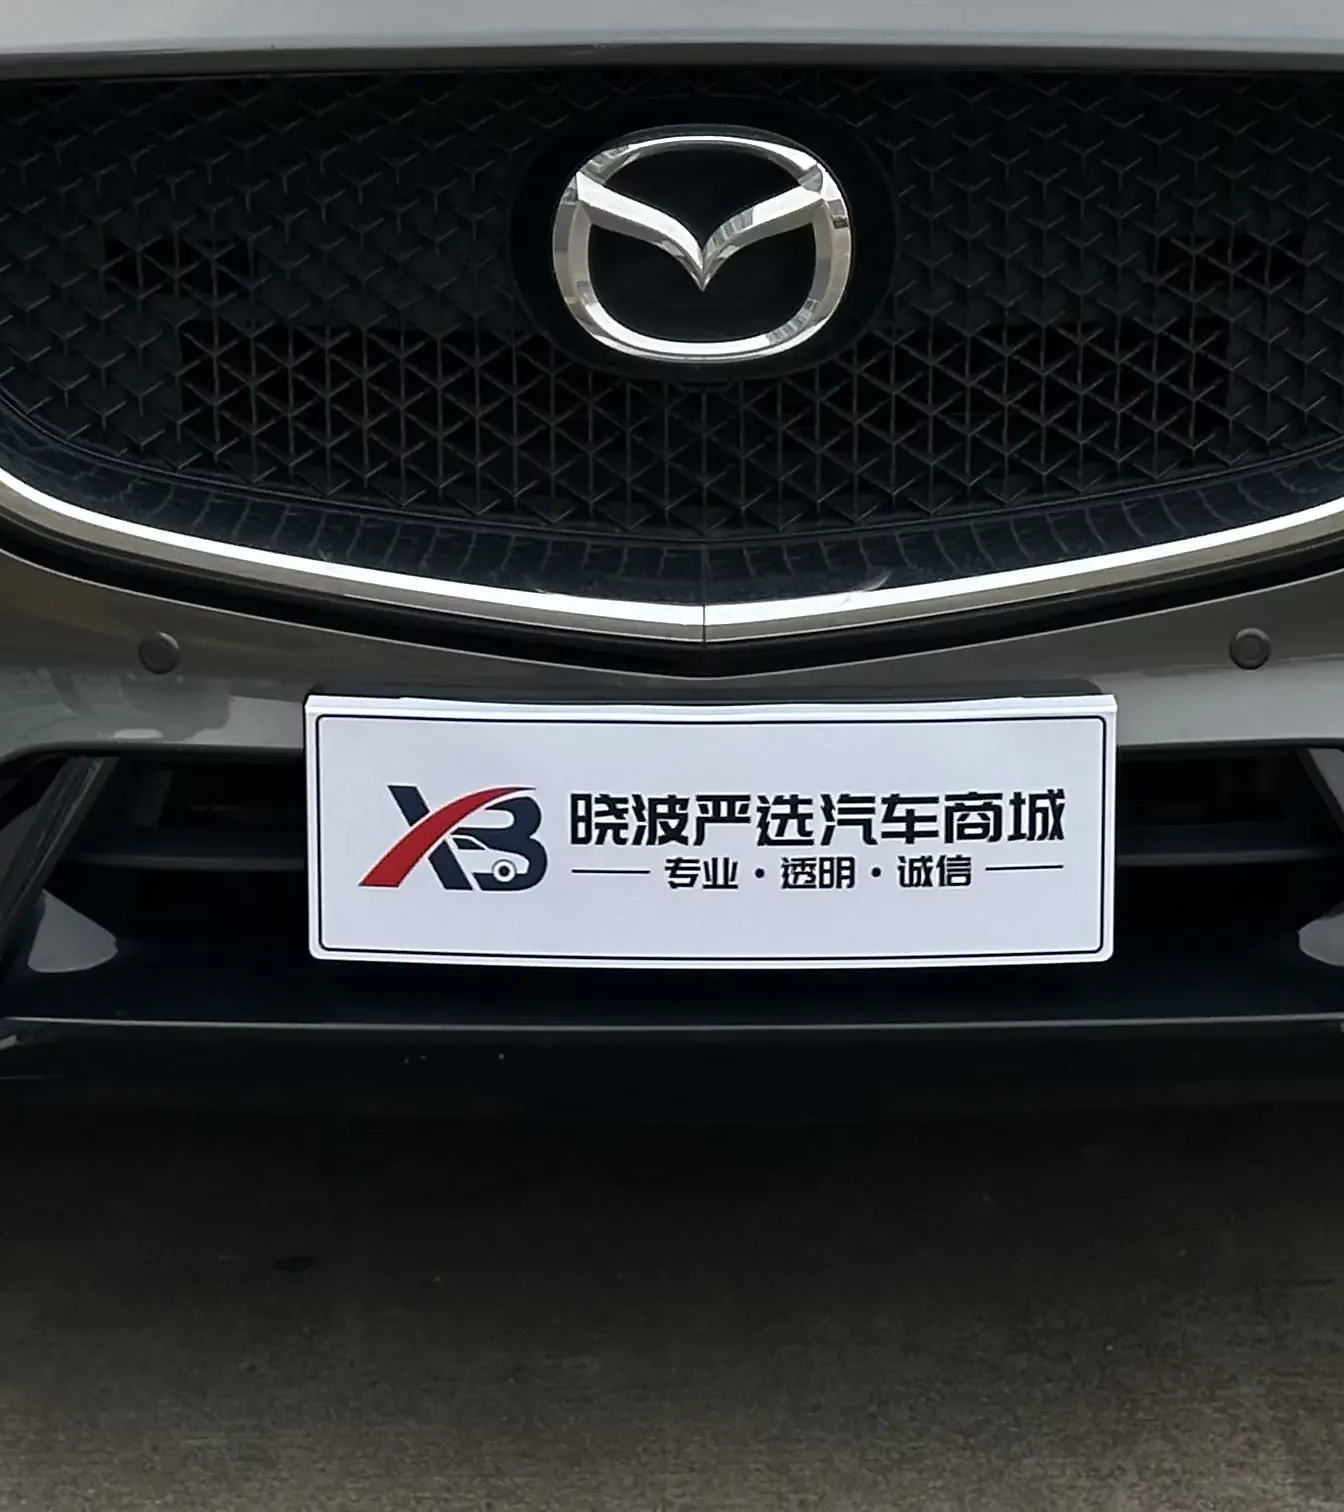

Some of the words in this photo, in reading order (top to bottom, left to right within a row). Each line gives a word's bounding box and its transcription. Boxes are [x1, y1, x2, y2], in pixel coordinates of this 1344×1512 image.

[570, 788, 1065, 846] 晓波严选汽车商城
